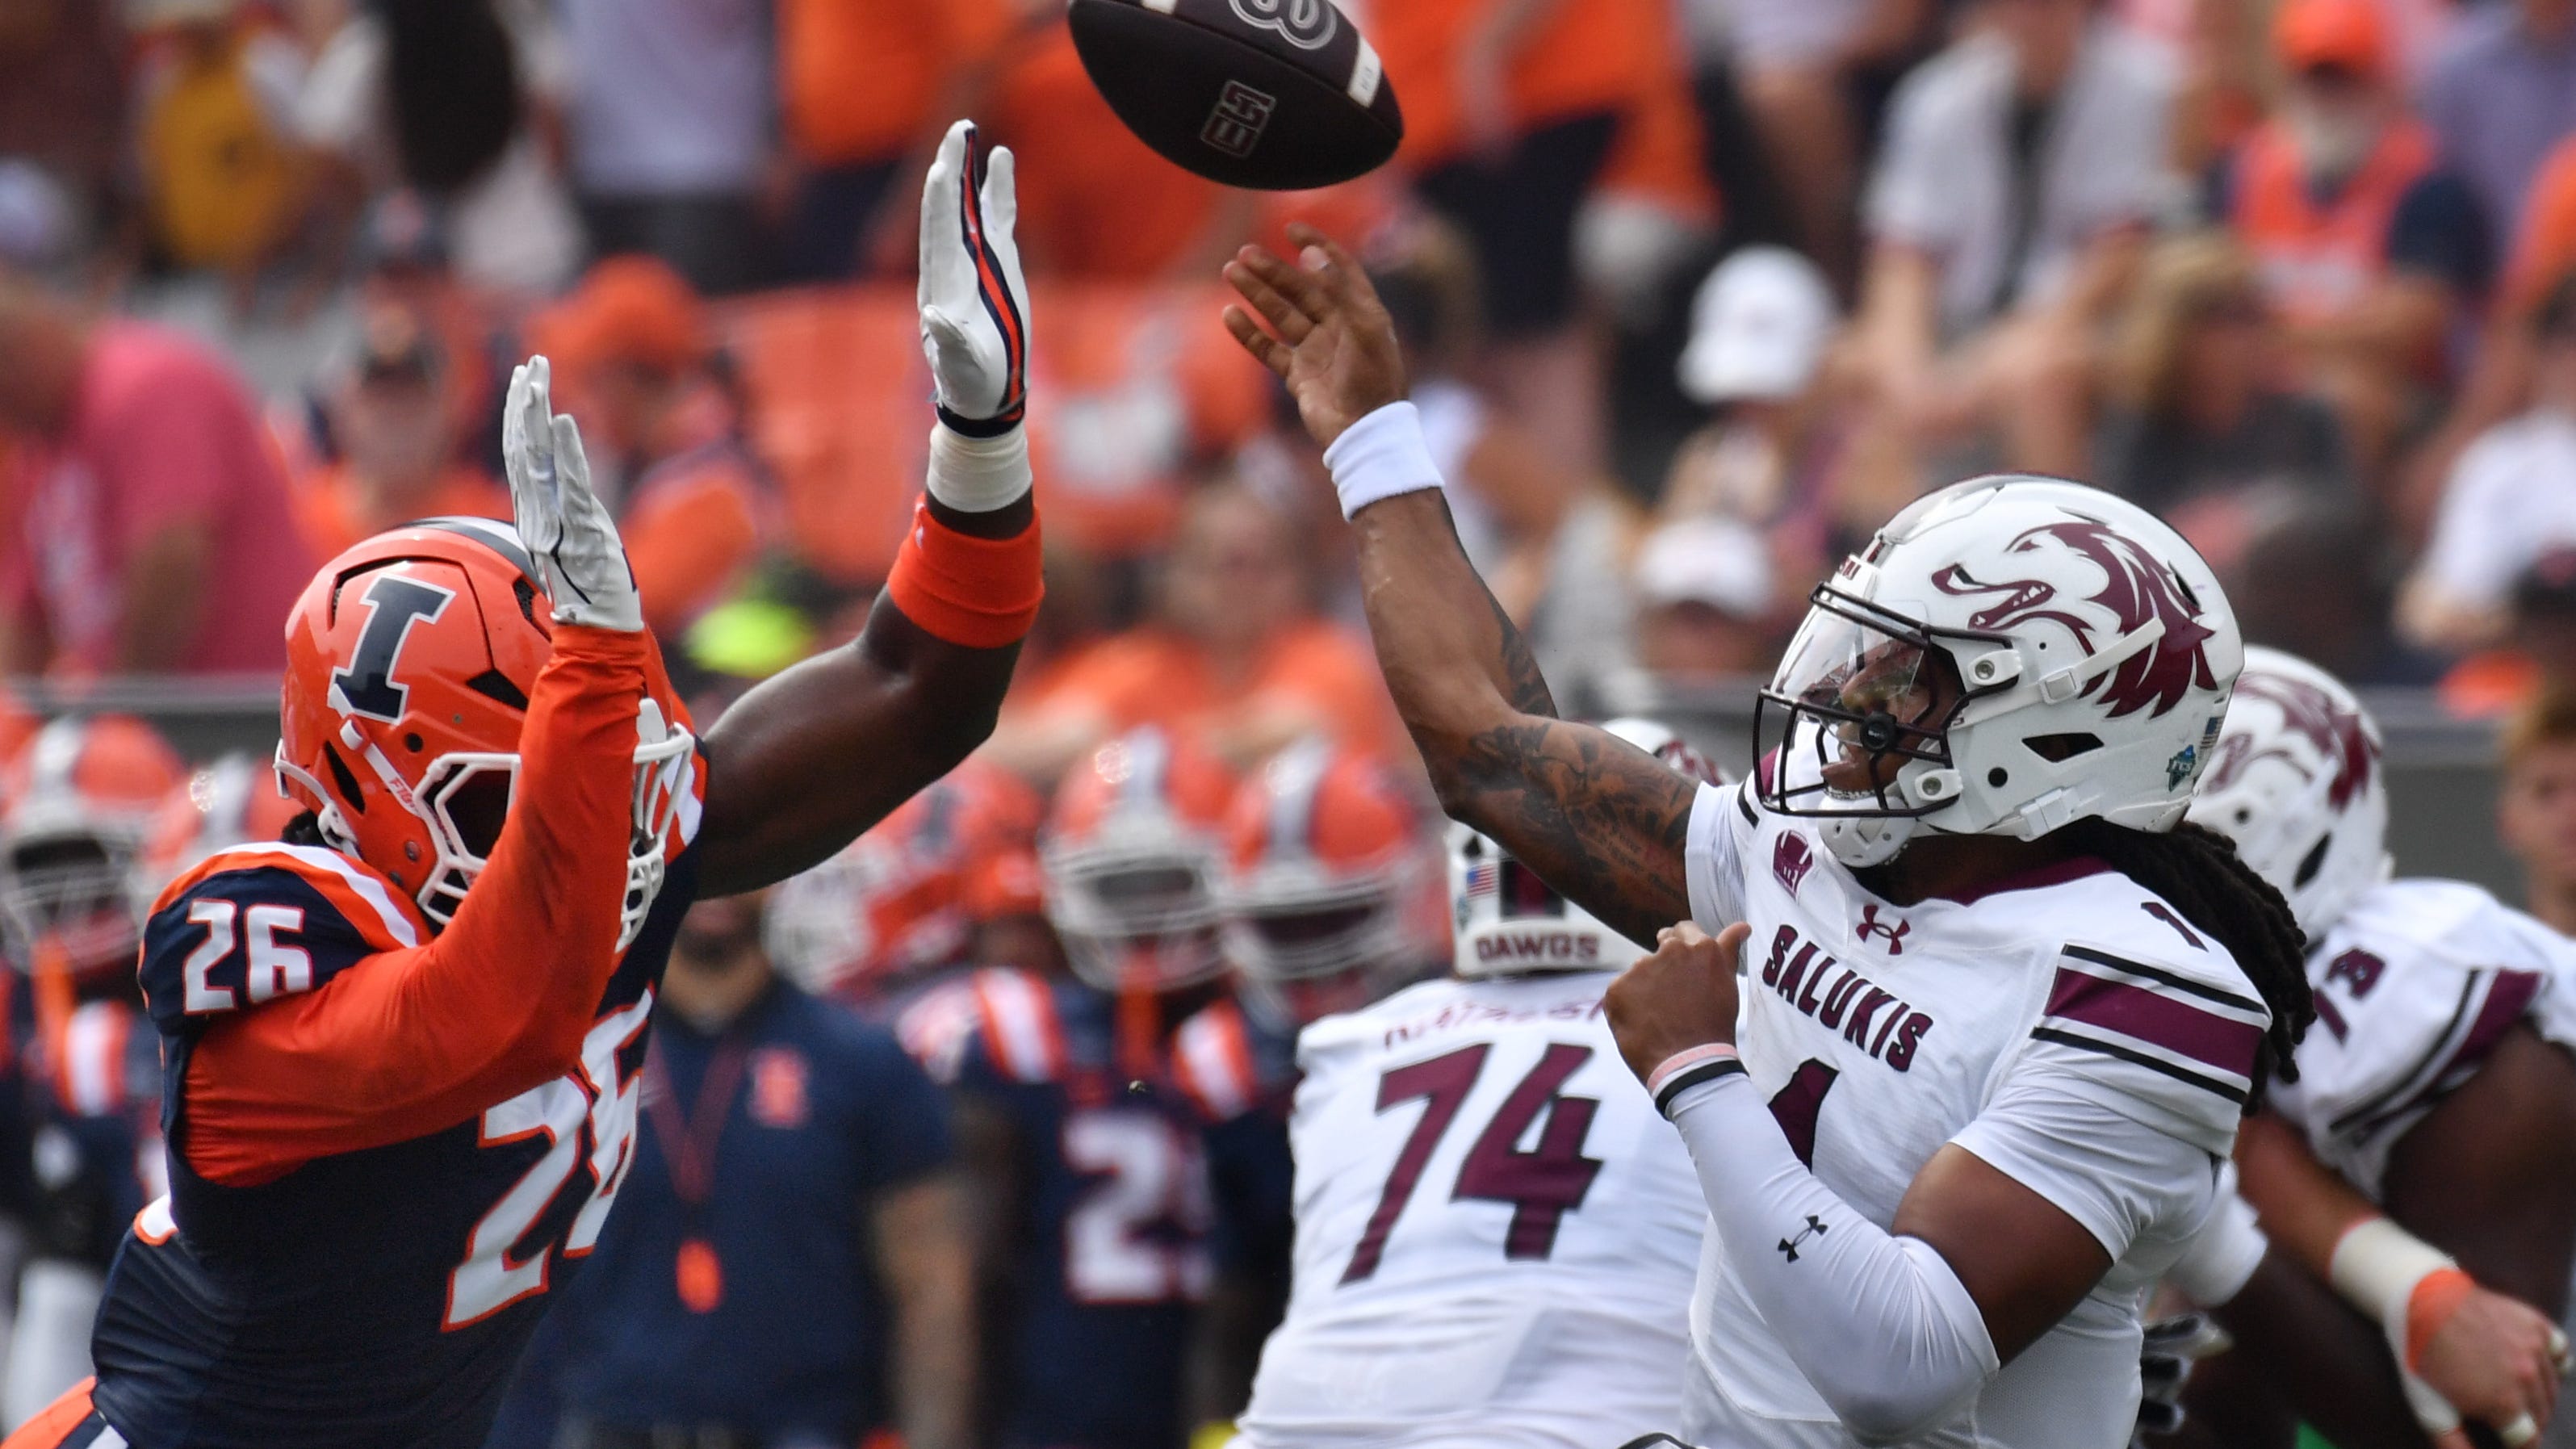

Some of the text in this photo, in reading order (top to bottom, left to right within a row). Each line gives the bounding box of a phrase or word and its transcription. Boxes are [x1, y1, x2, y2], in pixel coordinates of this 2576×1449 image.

[326, 572, 456, 727] I
[182, 897, 314, 1016] 26
[1476, 933, 1599, 962] DAWGS
[1761, 923, 1933, 1072] SALUKIS
[2140, 901, 2209, 953] 1
[441, 980, 656, 1334] 26
[1337, 1041, 1605, 1290] 74
